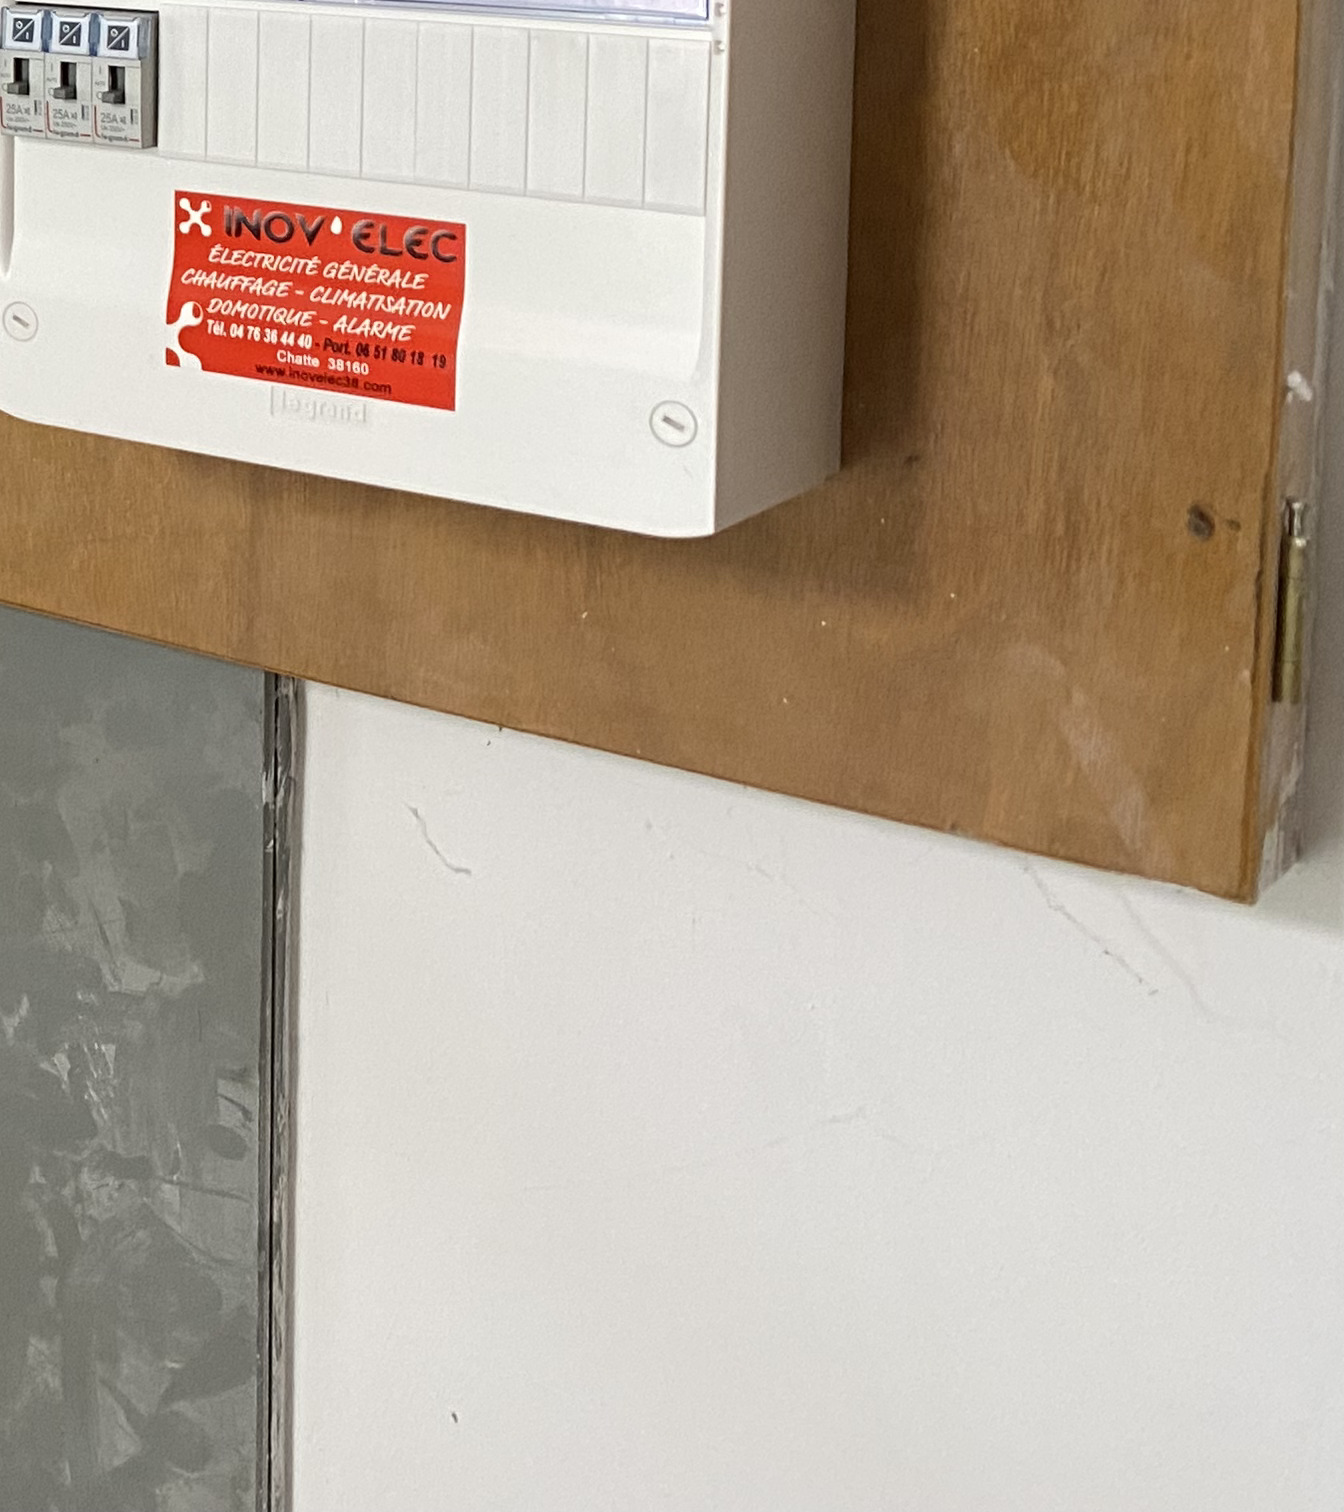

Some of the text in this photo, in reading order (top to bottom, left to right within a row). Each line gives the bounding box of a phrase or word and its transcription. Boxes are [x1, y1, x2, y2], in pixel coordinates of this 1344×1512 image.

[352, 219, 457, 263] ELEC
[208, 244, 429, 290] ÉLECTRICITÉ GÉNÉRALE
[180, 268, 293, 298] CHAUFFAGE
[310, 286, 452, 320] CLIMATISATION
[206, 298, 317, 328] DOMOTIQUE
[332, 314, 416, 342] ALARME
[207, 320, 226, 337] Tél.
[230, 323, 244, 339] 04
[248, 326, 260, 342] 76
[264, 328, 278, 344] 36
[280, 331, 295, 346] 44
[298, 334, 312, 350] 40
[323, 338, 351, 355] Port.
[374, 345, 387, 360] 51
[410, 350, 424, 366] 18
[432, 354, 446, 369] 19
[276, 350, 369, 375] Chatte 38160
